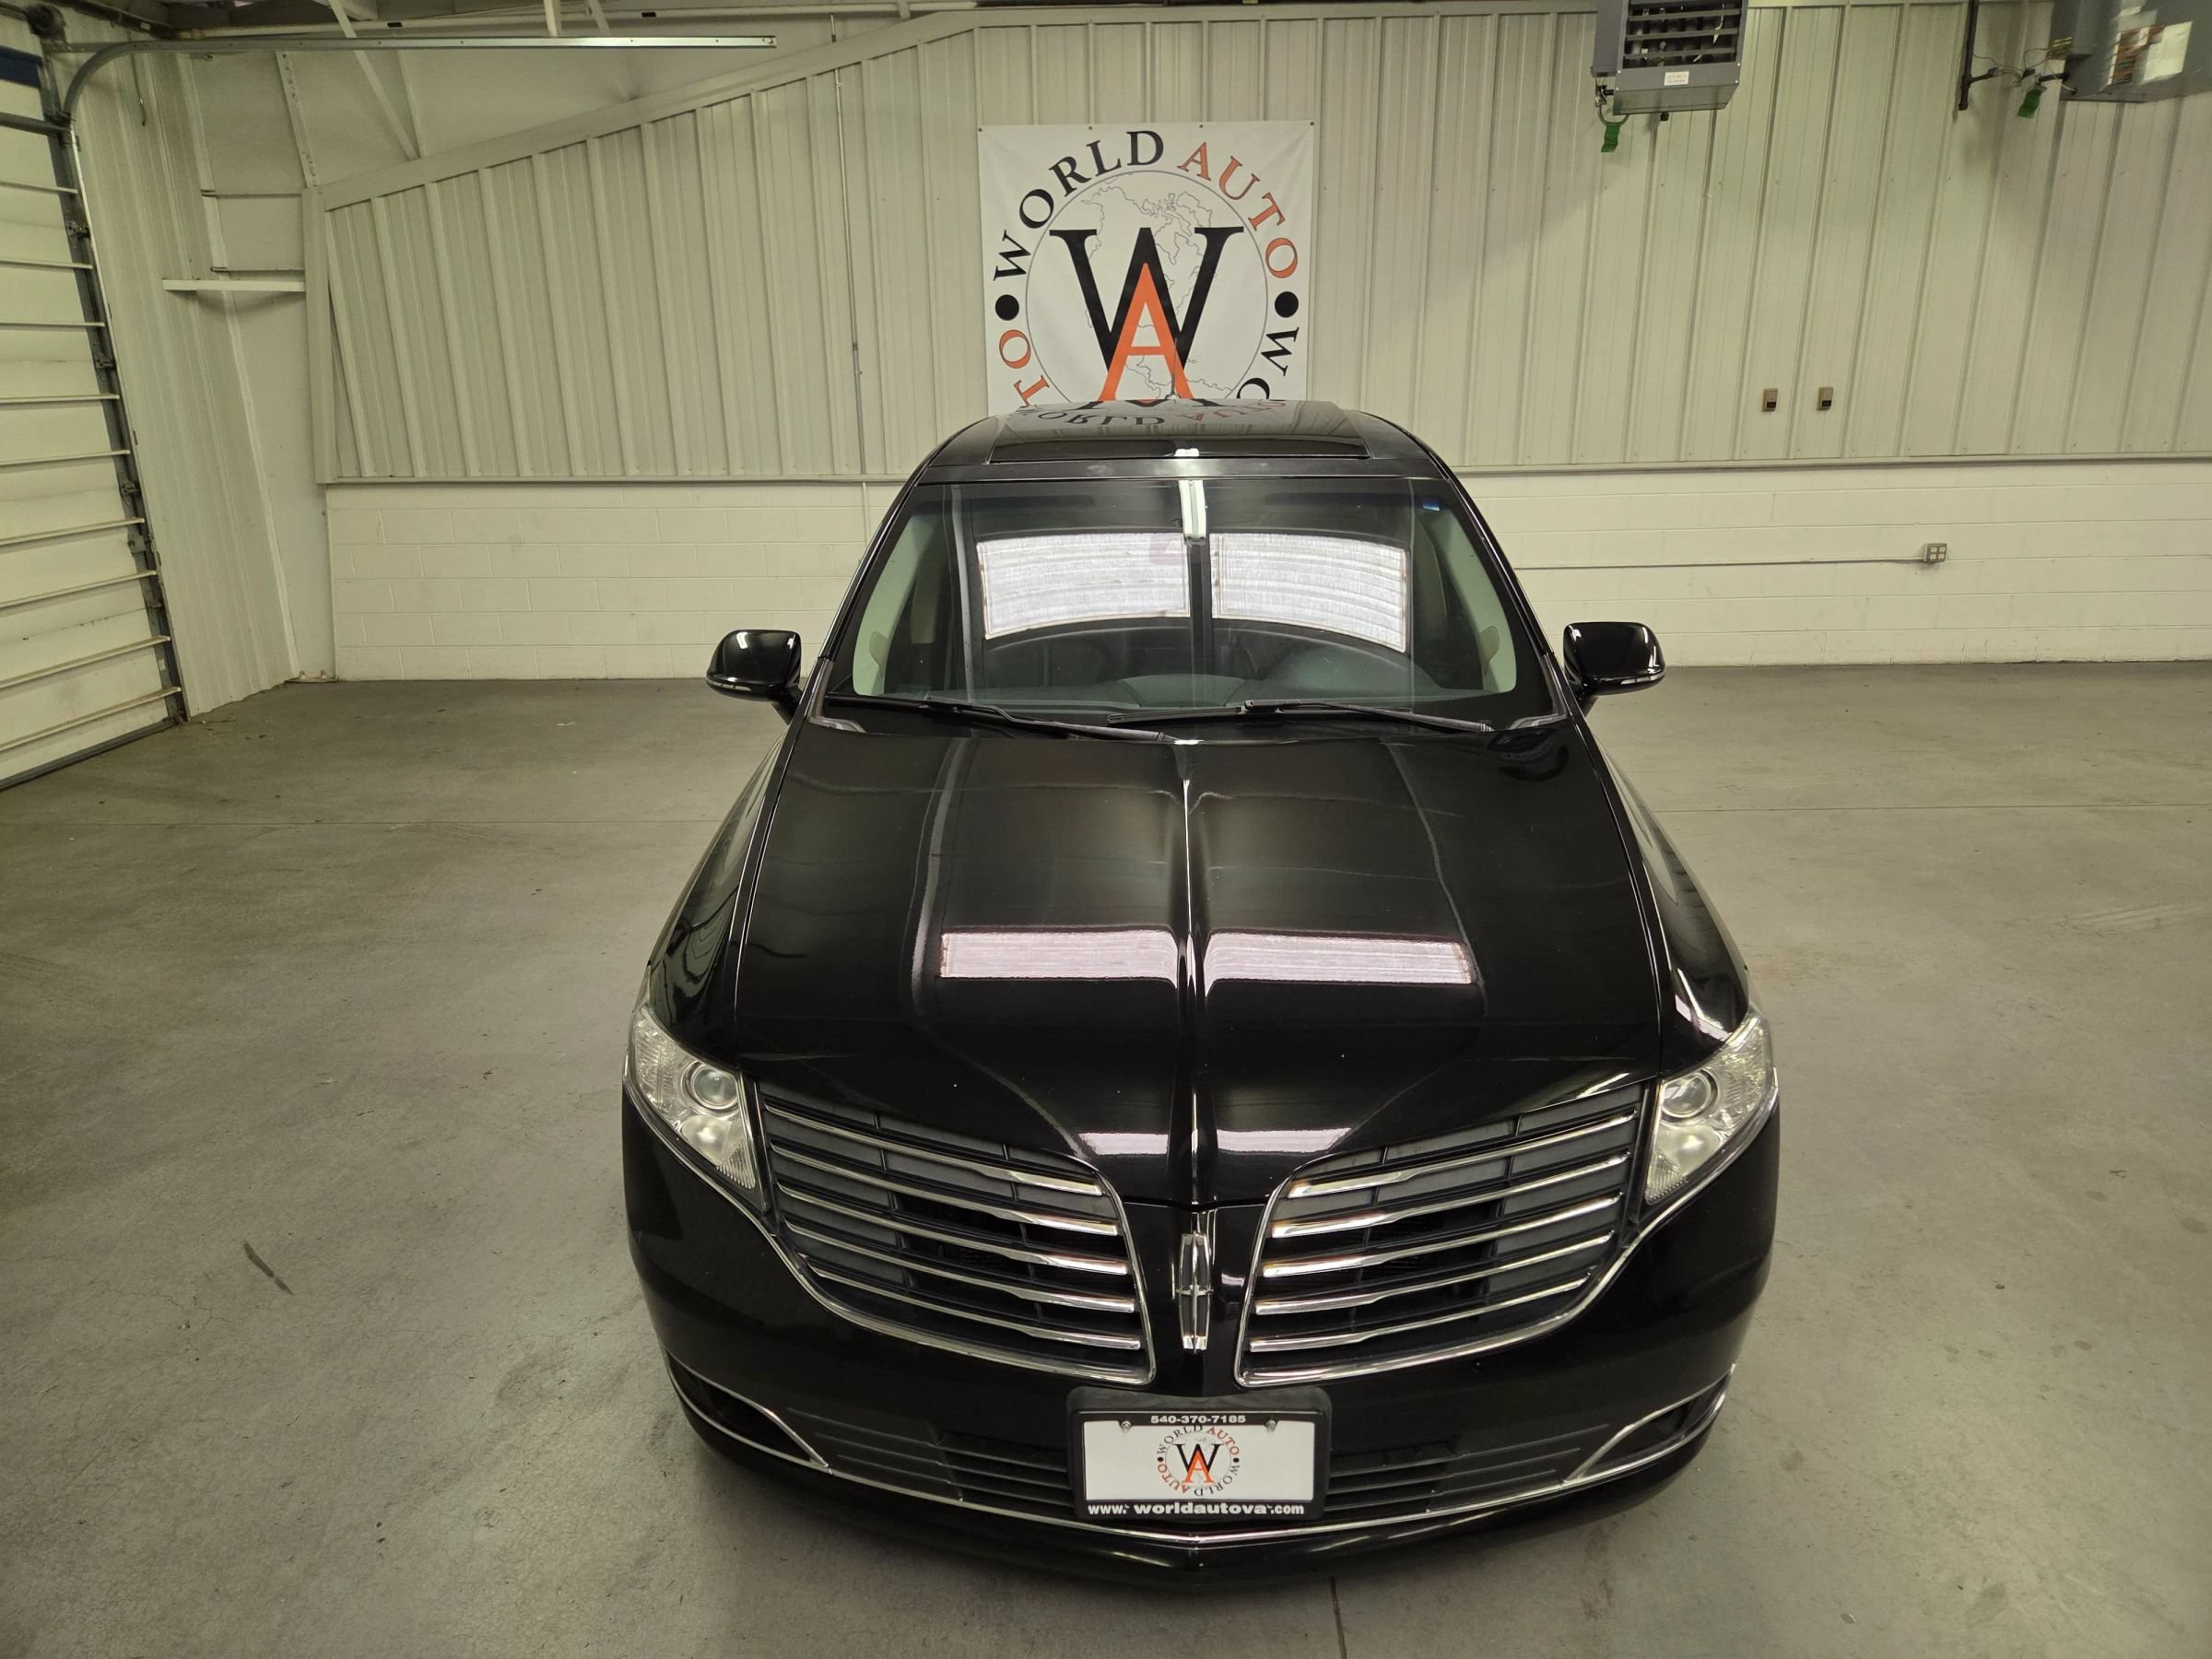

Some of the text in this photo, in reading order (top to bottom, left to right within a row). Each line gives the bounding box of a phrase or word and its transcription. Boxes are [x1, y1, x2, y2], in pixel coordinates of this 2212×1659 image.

[993, 130, 1298, 281] WORLD AUTO
[1150, 1415, 1246, 1424] 540-370-7185
[1157, 1425, 1240, 1455] WORLD AUTO
